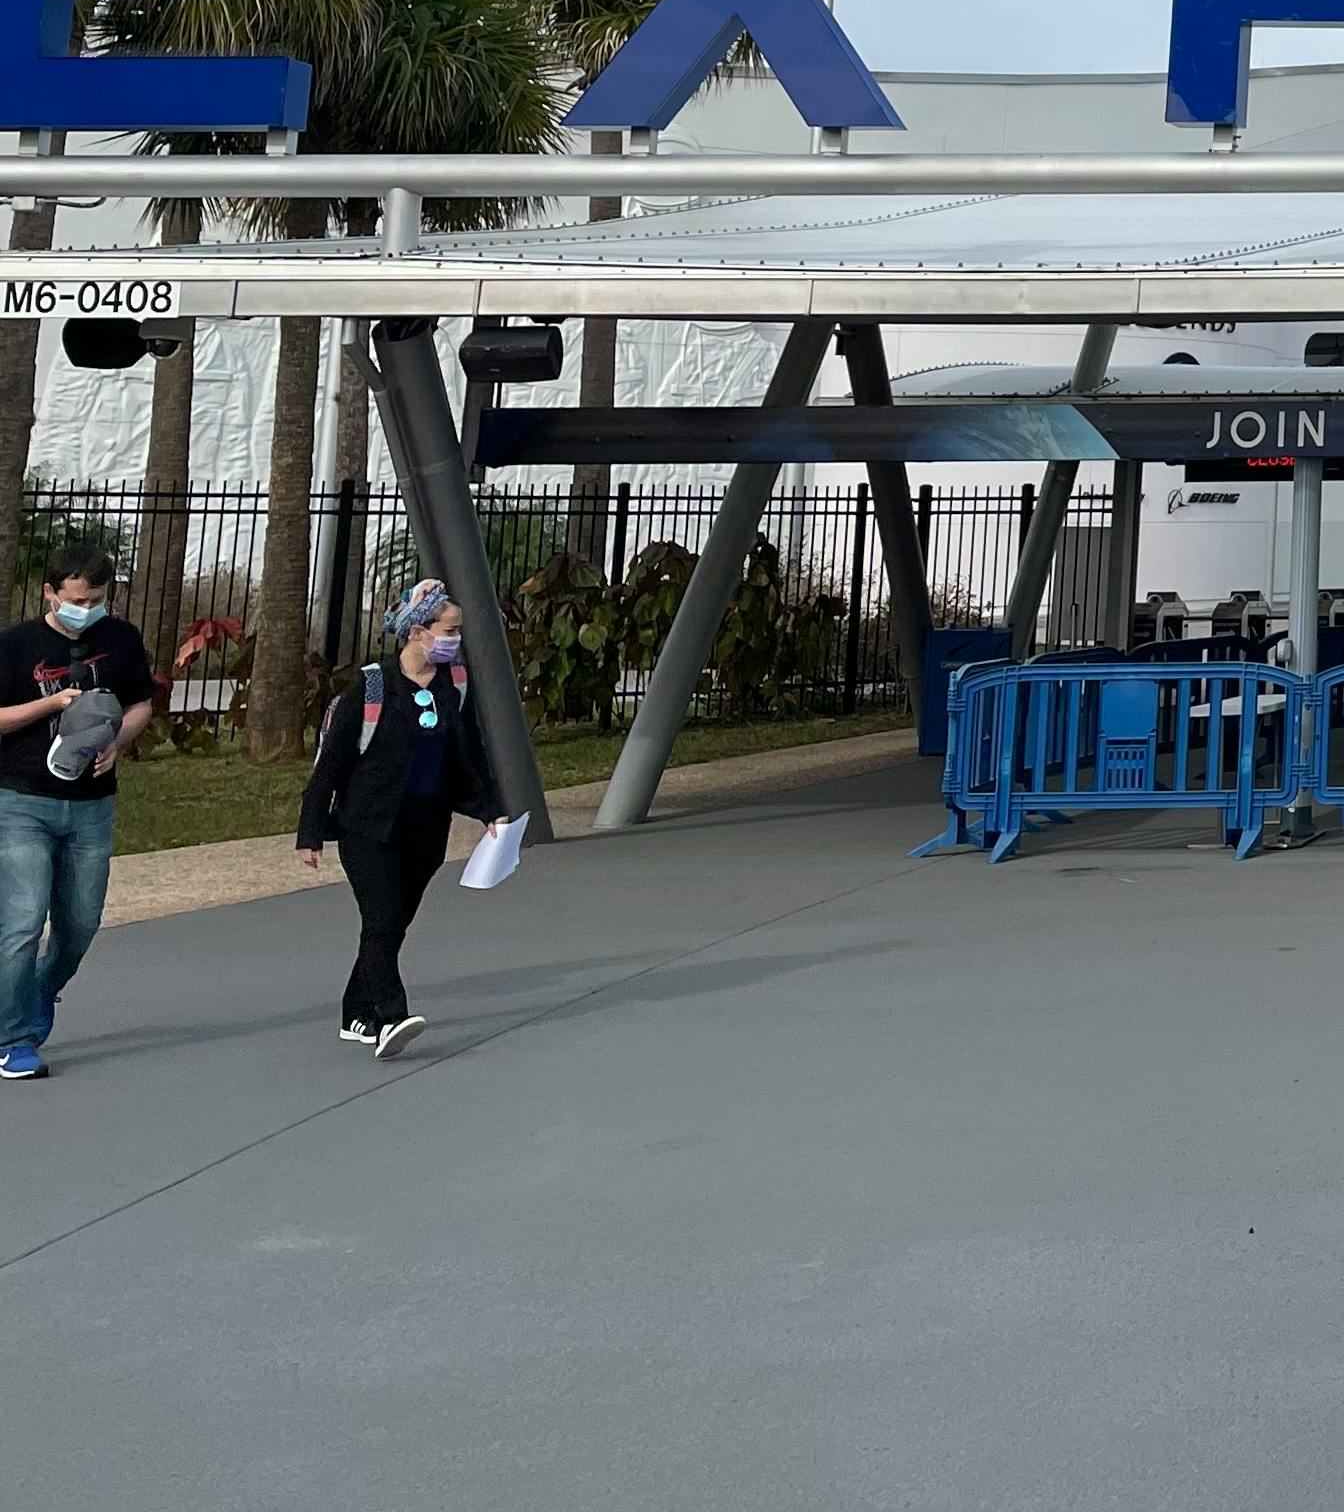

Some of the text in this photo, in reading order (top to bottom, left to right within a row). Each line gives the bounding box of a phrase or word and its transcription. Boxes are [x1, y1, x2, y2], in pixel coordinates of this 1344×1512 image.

[4, 281, 172, 313] M6-0408
[1206, 410, 1325, 449] JOIN
[1188, 492, 1240, 504] BOEING
